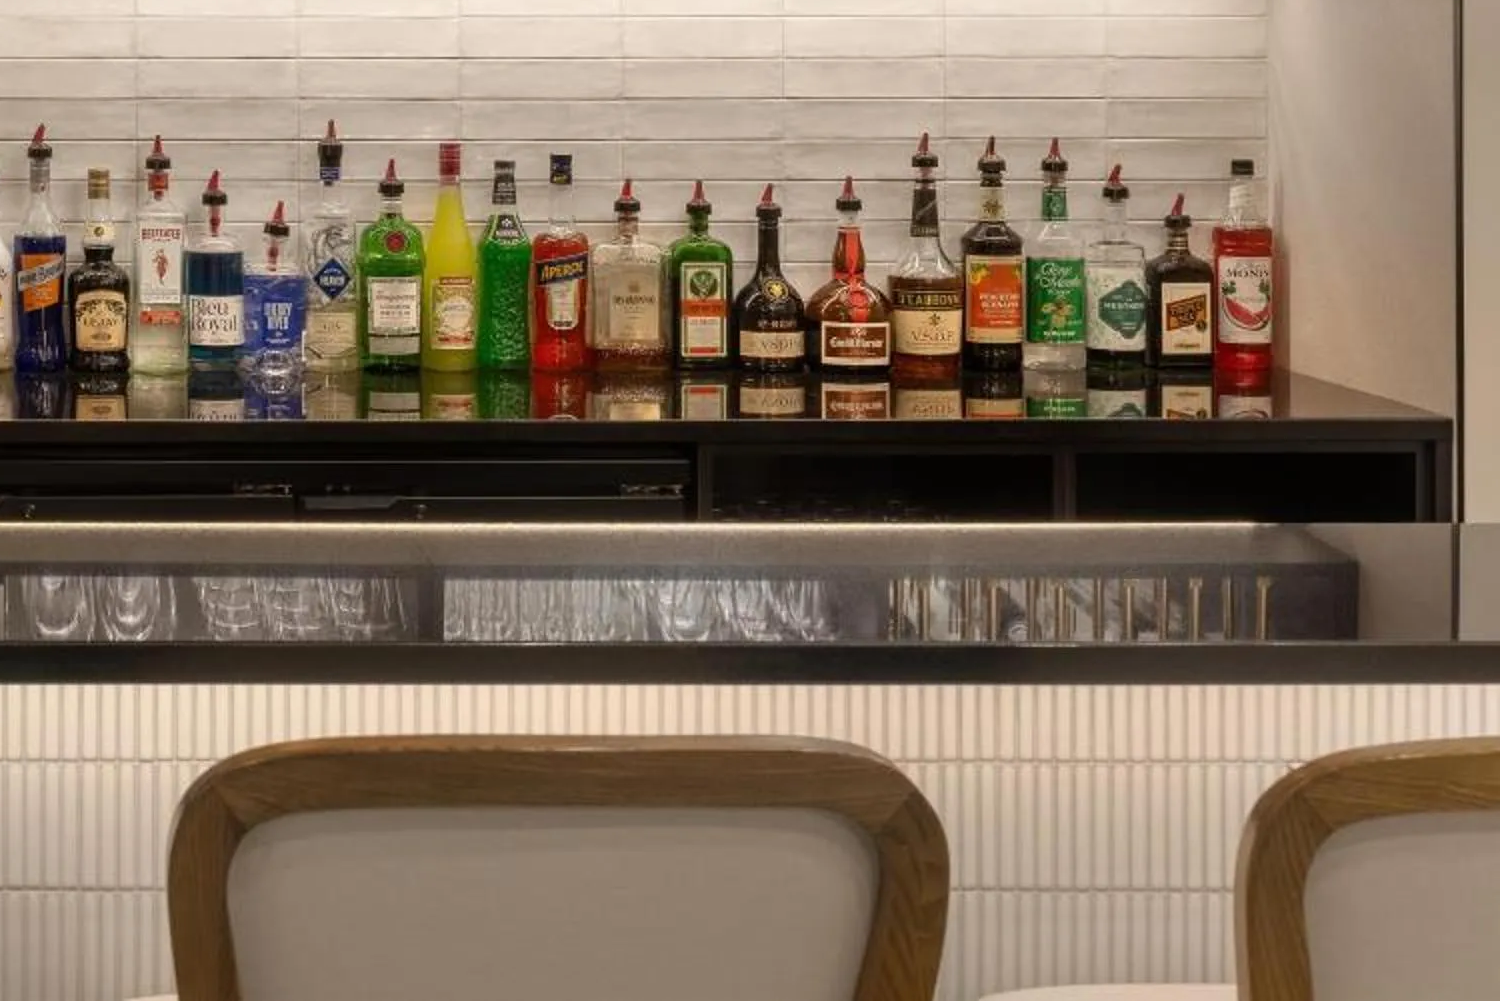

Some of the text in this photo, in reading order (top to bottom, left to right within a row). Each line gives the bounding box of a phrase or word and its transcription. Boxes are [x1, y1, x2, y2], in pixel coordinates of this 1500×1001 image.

[541, 261, 585, 282] APEROL
[192, 298, 229, 316] Bleu
[192, 316, 237, 334] Royal
